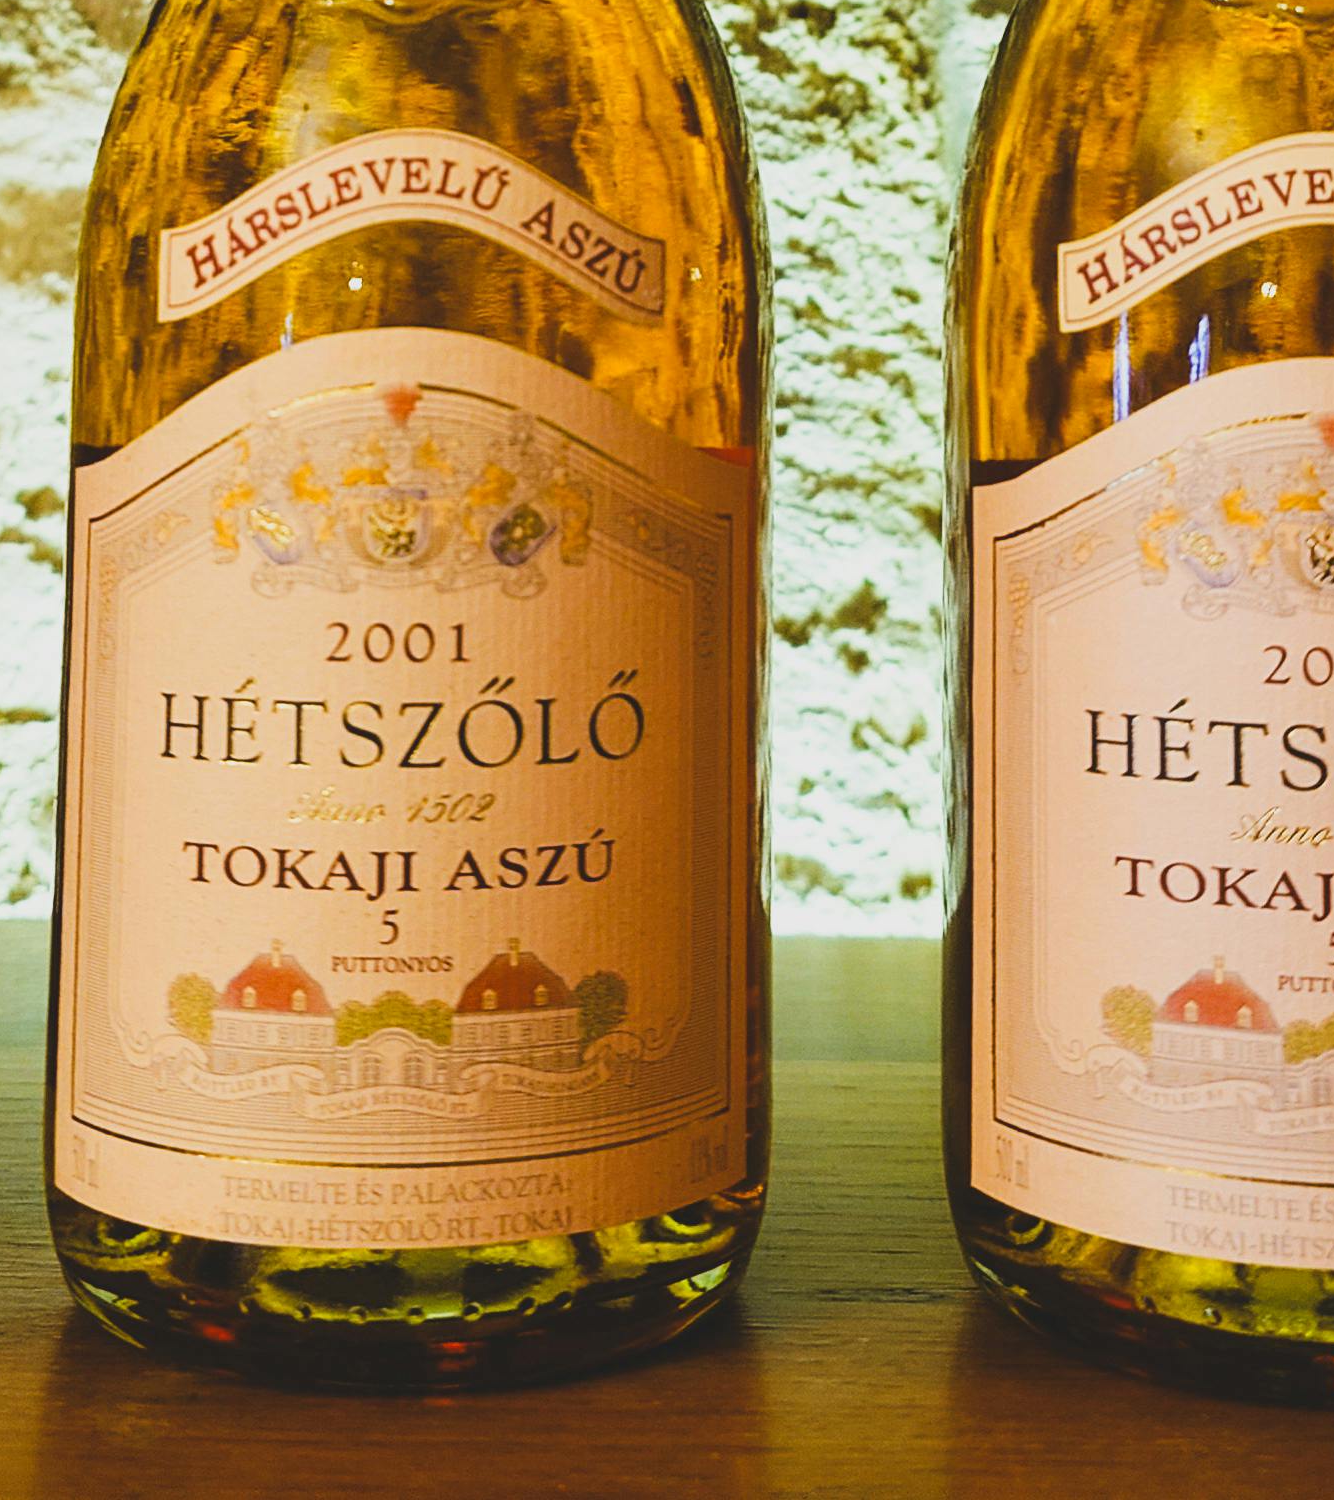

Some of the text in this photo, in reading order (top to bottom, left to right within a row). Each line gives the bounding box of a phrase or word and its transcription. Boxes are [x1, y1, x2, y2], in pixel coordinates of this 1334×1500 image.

[185, 156, 646, 295] HÁRSLEVELŰ ASZÚ
[325, 621, 472, 664] 2001
[159, 668, 646, 770] HÉTSZŐLŐ
[406, 792, 497, 824] 1502
[1230, 805, 1334, 848] Anno
[182, 828, 617, 902] TOKAJI ASZÚ
[379, 908, 401, 946] 5
[331, 955, 455, 975] PUTTONYOS
[220, 1174, 350, 1206] TERMELTE
[354, 1179, 385, 1206] ÉS
[1166, 1185, 1302, 1224] TERMELTE
